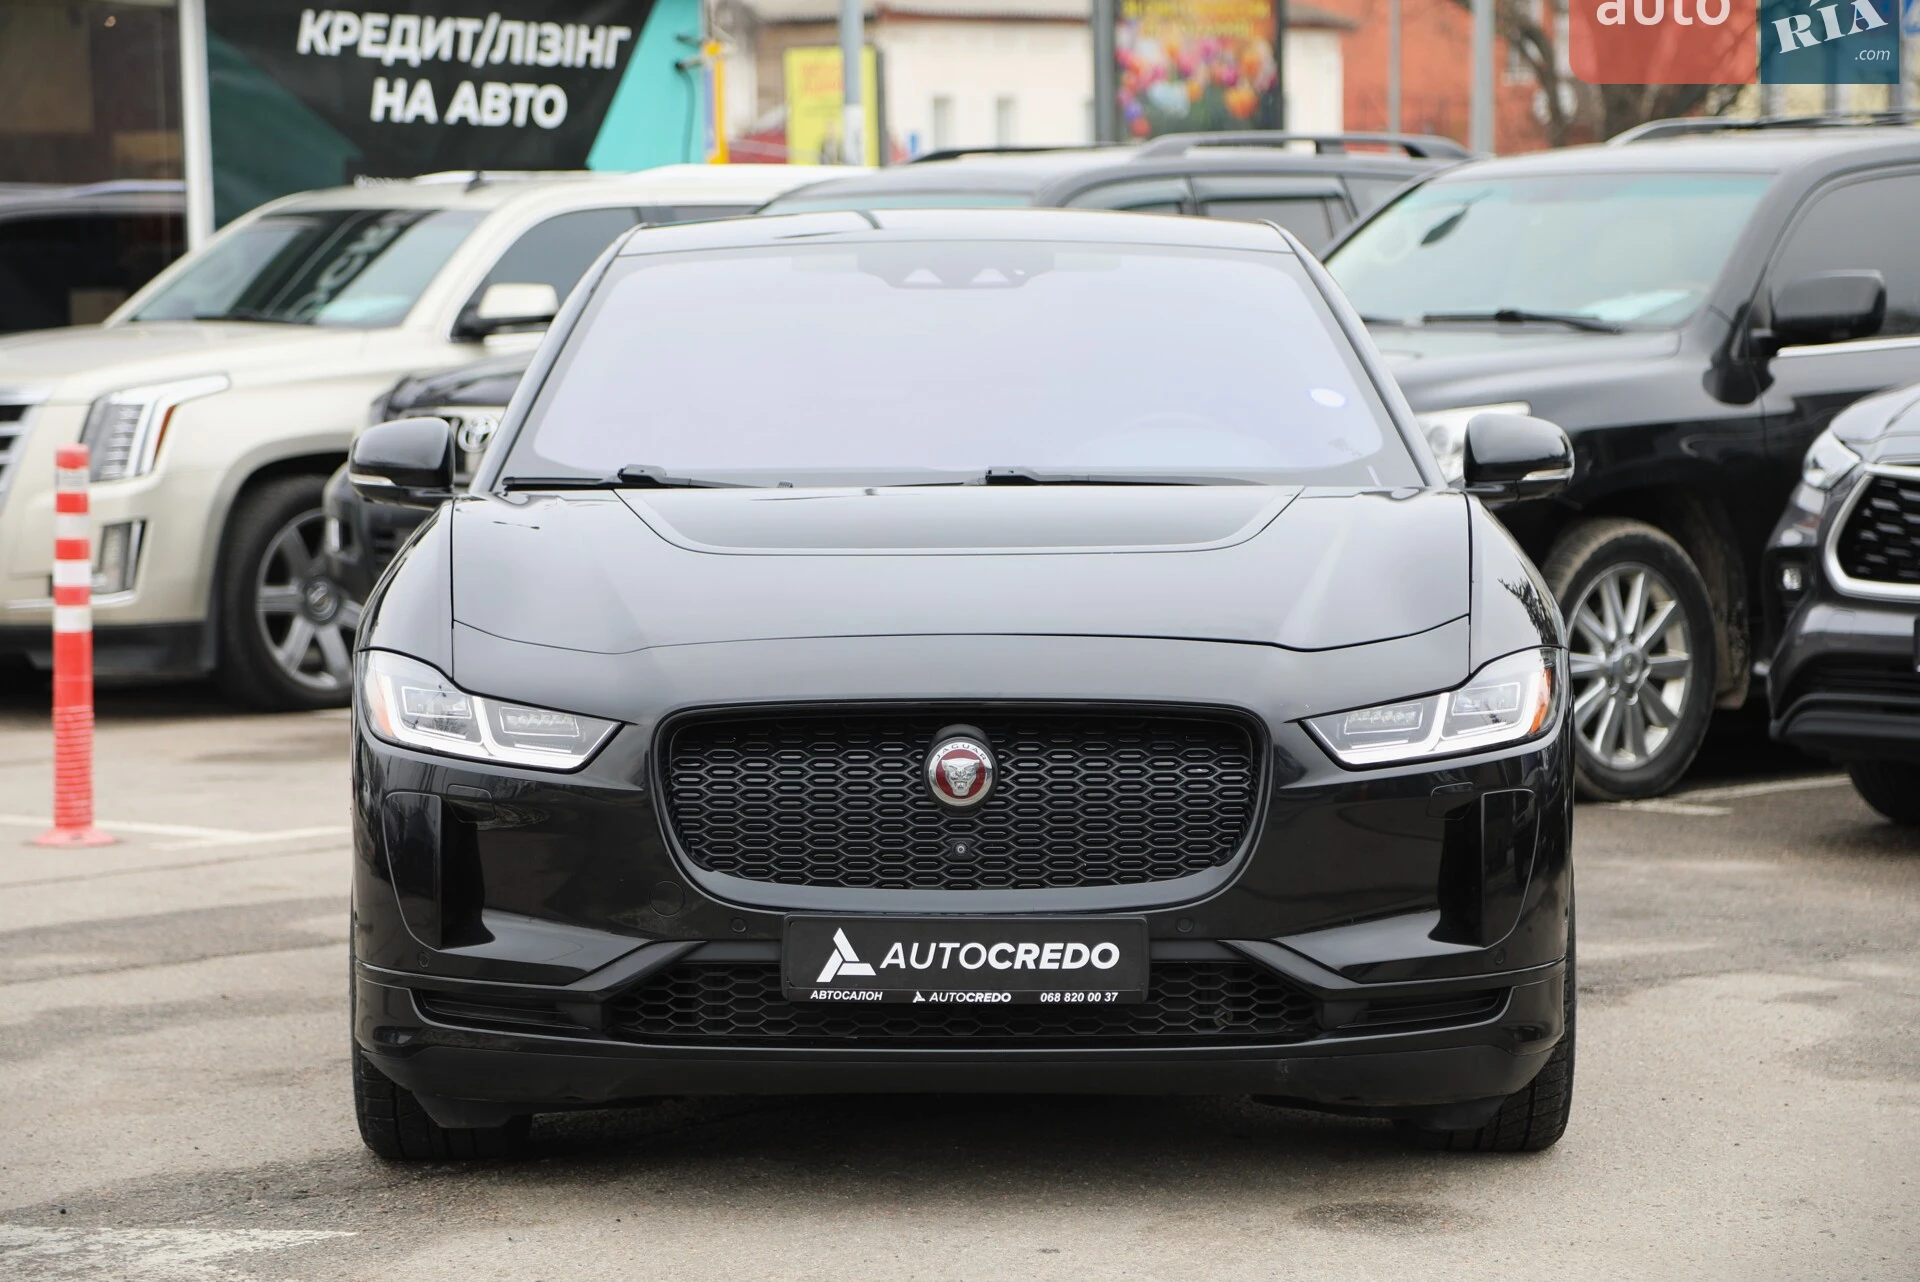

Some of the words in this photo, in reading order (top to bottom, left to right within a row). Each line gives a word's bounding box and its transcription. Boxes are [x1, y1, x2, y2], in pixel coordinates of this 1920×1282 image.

[297, 9, 632, 69] КРЕДИТ/ЛІЗІНГ
[370, 77, 439, 124] НА
[444, 80, 569, 129] АВТО
[936, 743, 987, 761] JAGUAR
[879, 942, 1120, 970] AUTOCREDO
[810, 989, 883, 1001] АВТОСАЛОН
[929, 991, 1011, 1003] AUTOCREDO
[1040, 992, 1062, 1003] 068
[1064, 992, 1085, 1003] 820
[1087, 992, 1102, 1003] 00
[1104, 992, 1119, 1003] 37
